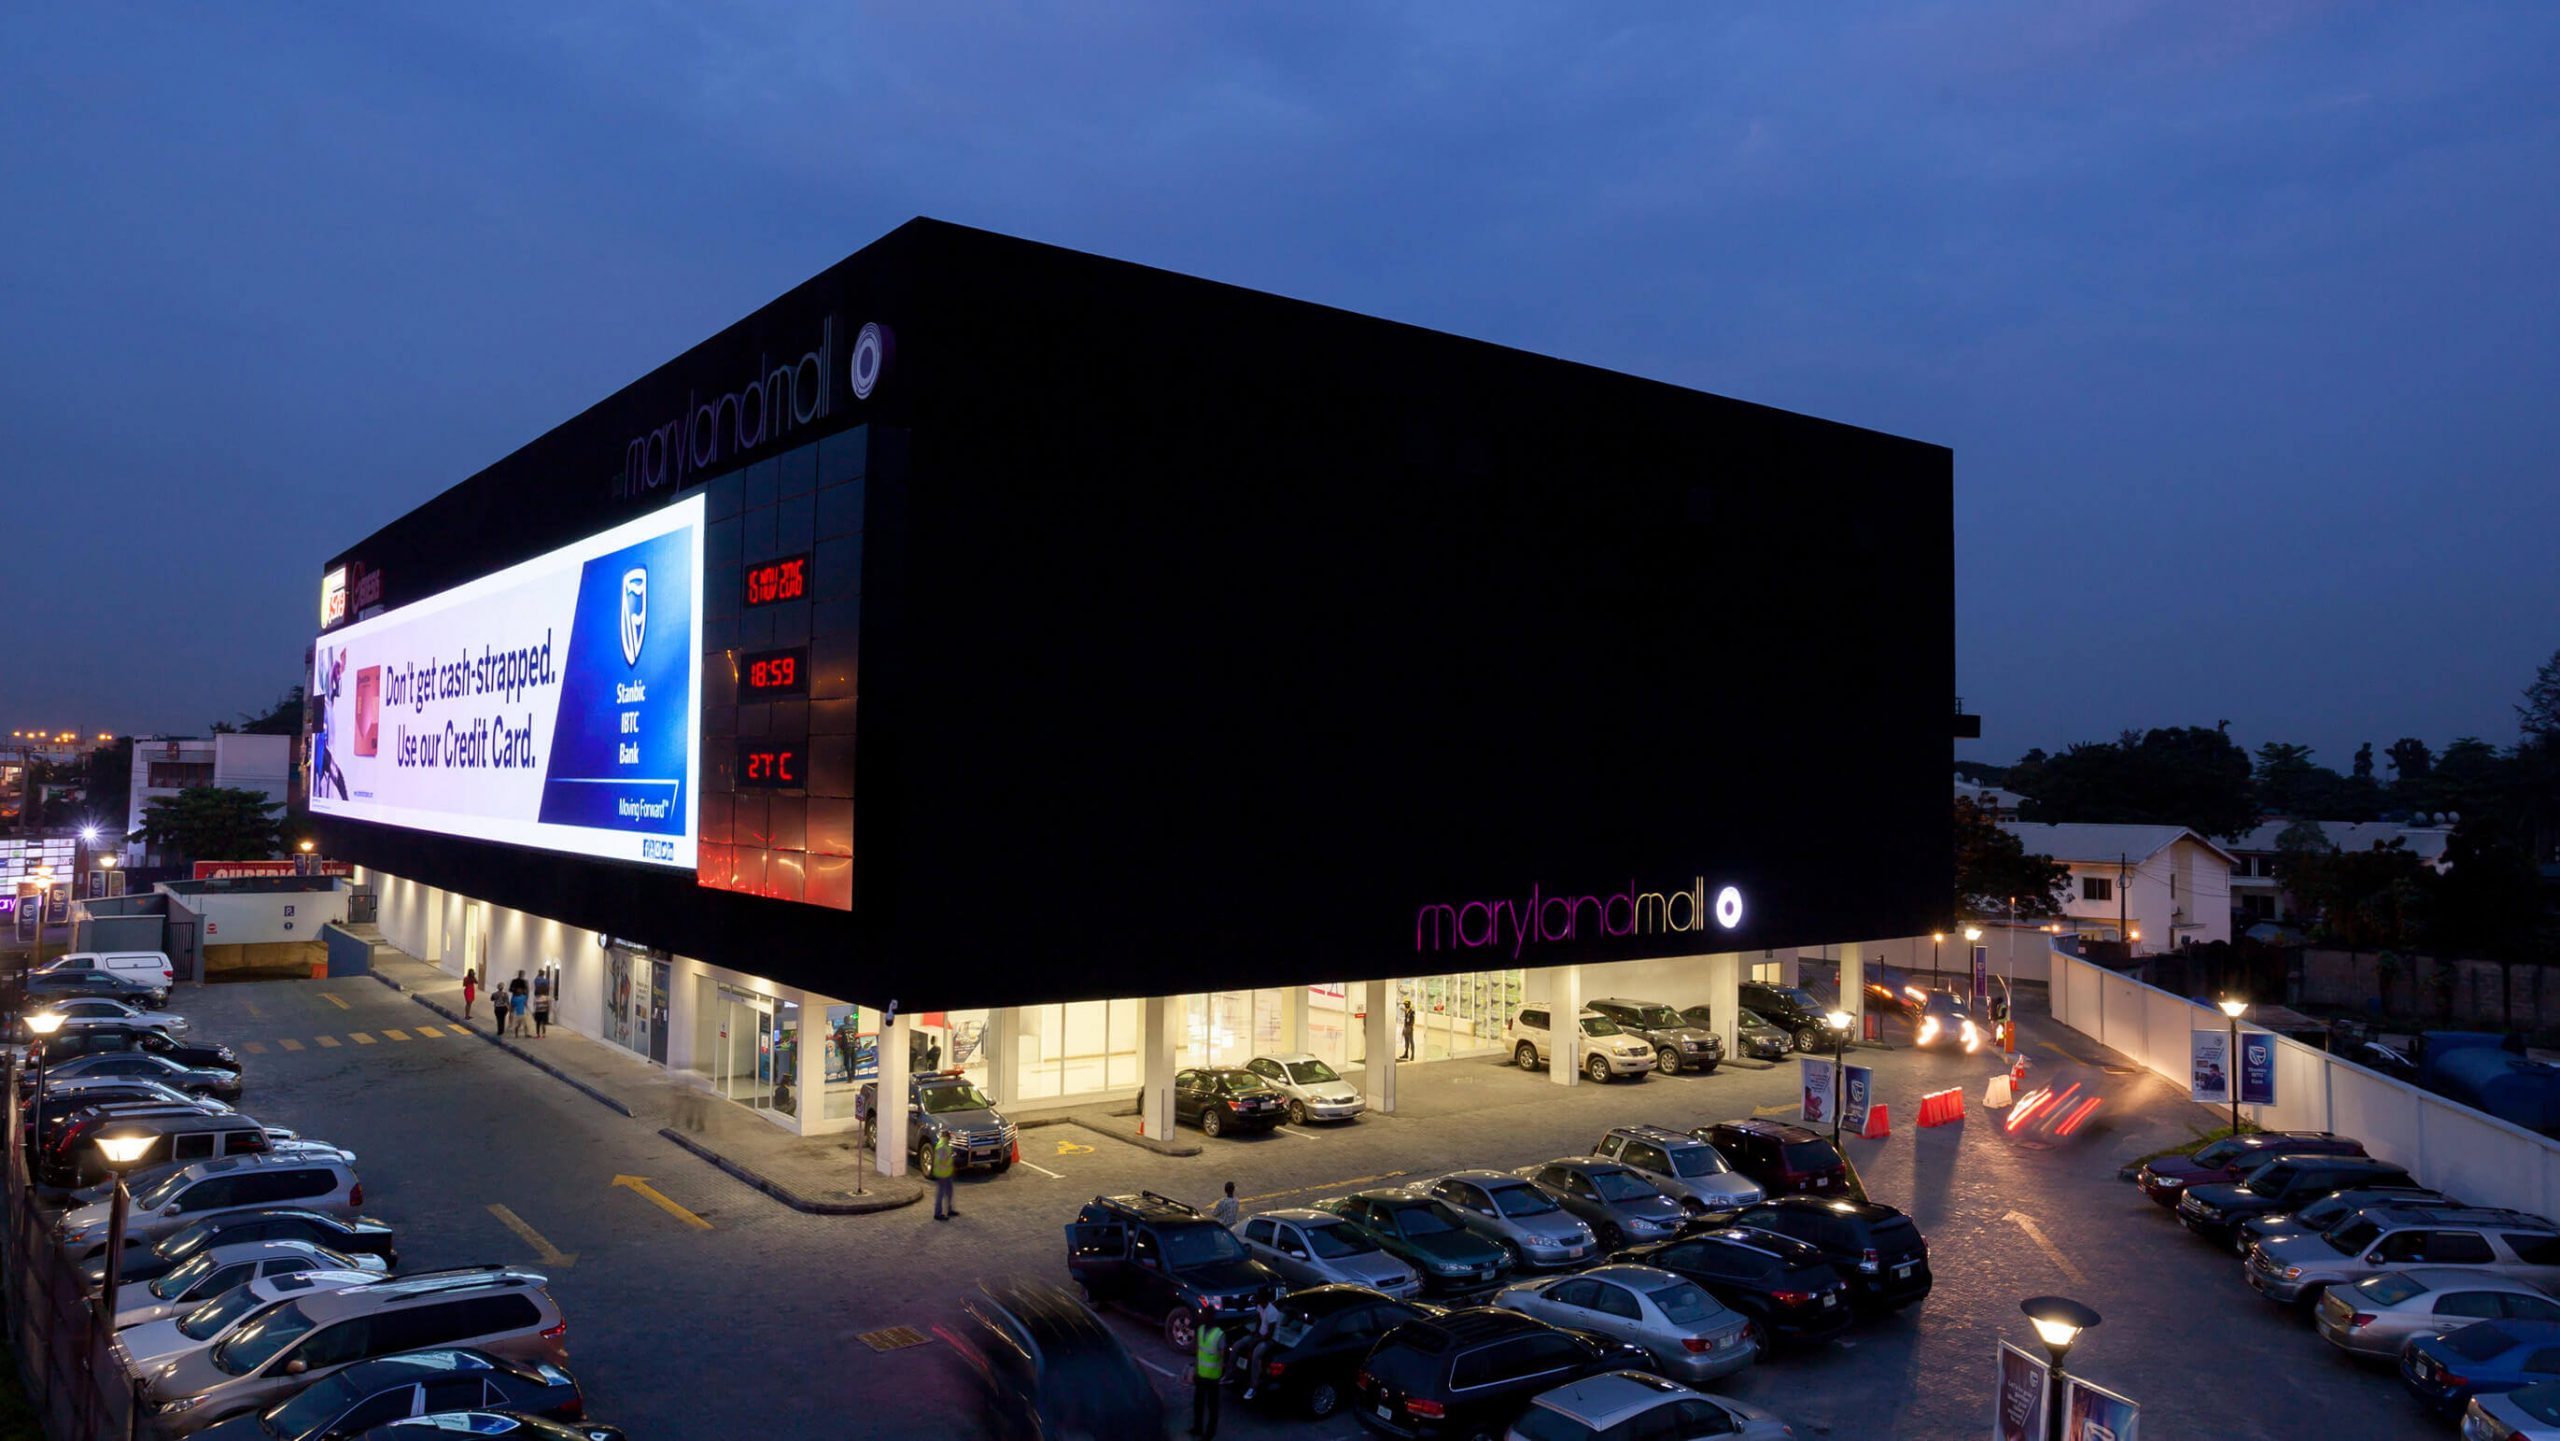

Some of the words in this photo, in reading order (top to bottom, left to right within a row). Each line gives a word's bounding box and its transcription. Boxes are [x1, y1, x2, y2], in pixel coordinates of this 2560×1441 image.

[386, 661, 415, 707] Don't
[415, 657, 437, 714] get
[439, 627, 556, 704] cash-strapped.
[751, 657, 795, 688] 18:59
[616, 679, 646, 705] Stanbic
[620, 710, 640, 735] IBTC
[397, 724, 417, 768] Use
[420, 733, 441, 768] our
[444, 717, 488, 768] Credit
[492, 712, 536, 769] Card.
[619, 740, 640, 765] Bank
[618, 797, 640, 822] Moving
[1417, 876, 1704, 959] marylandmall
